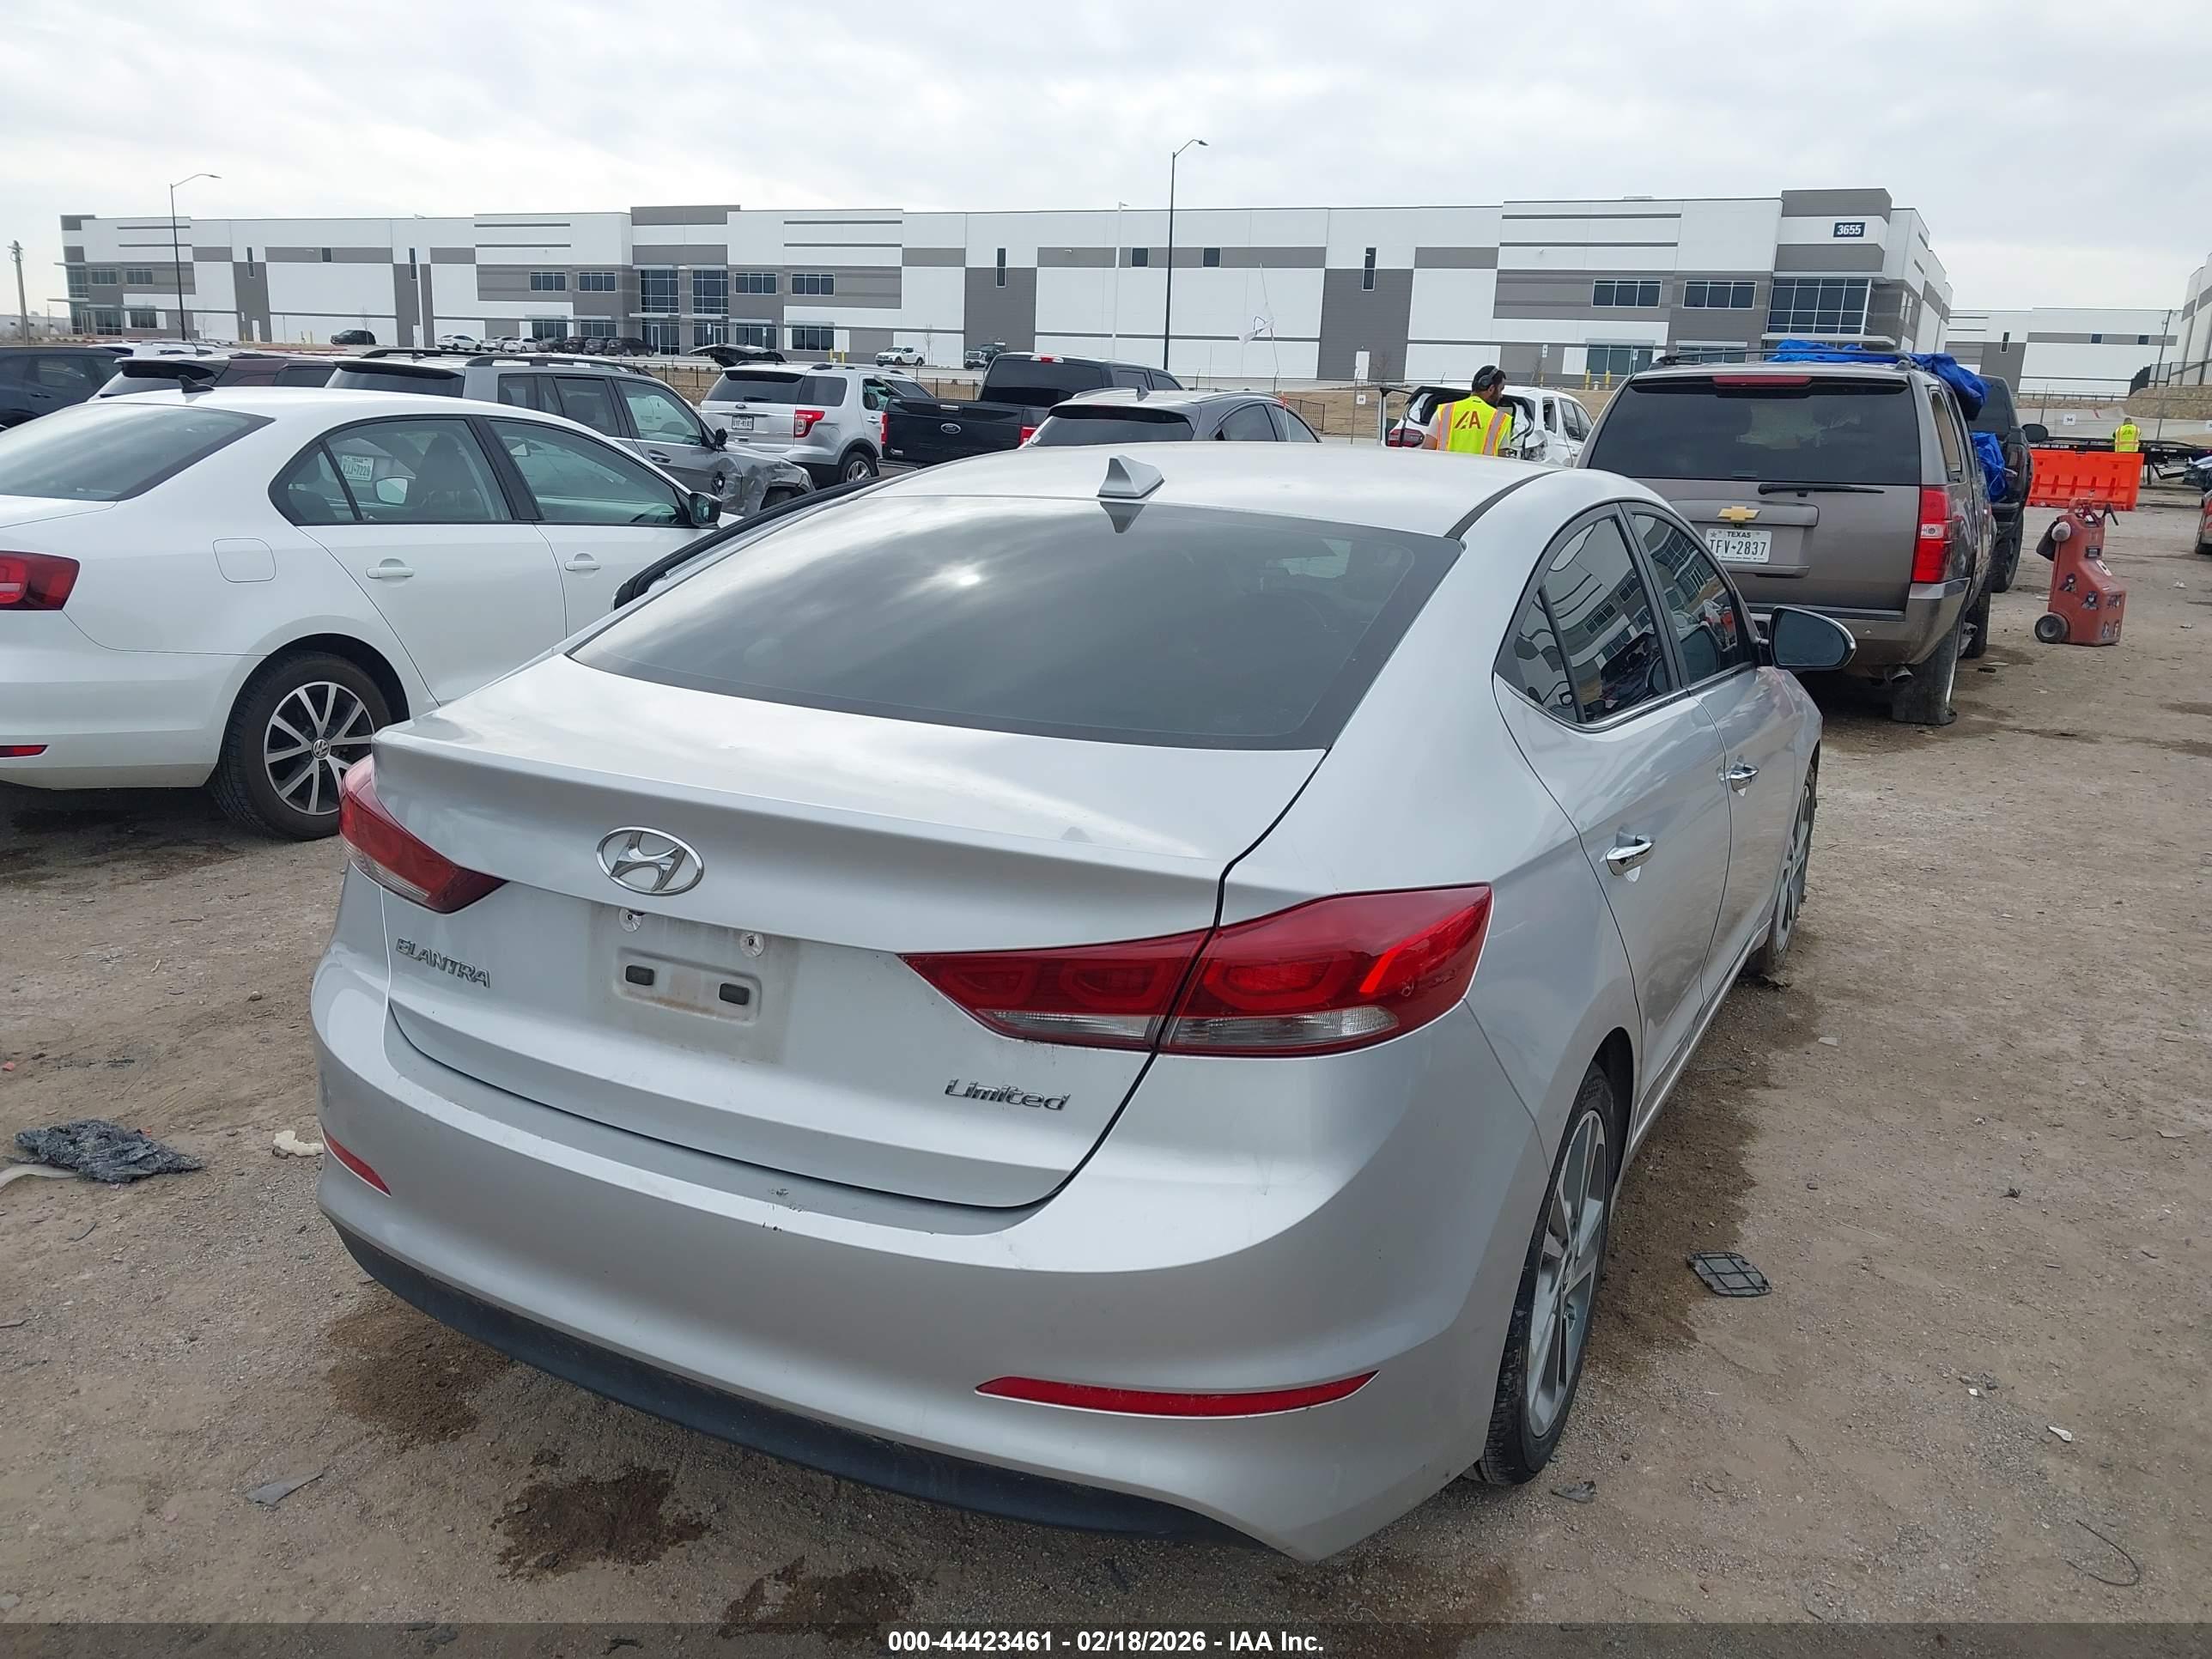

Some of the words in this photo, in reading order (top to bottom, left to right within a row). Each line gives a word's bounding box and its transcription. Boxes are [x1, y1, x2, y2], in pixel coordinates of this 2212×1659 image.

[1837, 224, 1862, 235] 3655
[395, 938, 491, 988] ELANTRA
[945, 1079, 1072, 1111] Limited
